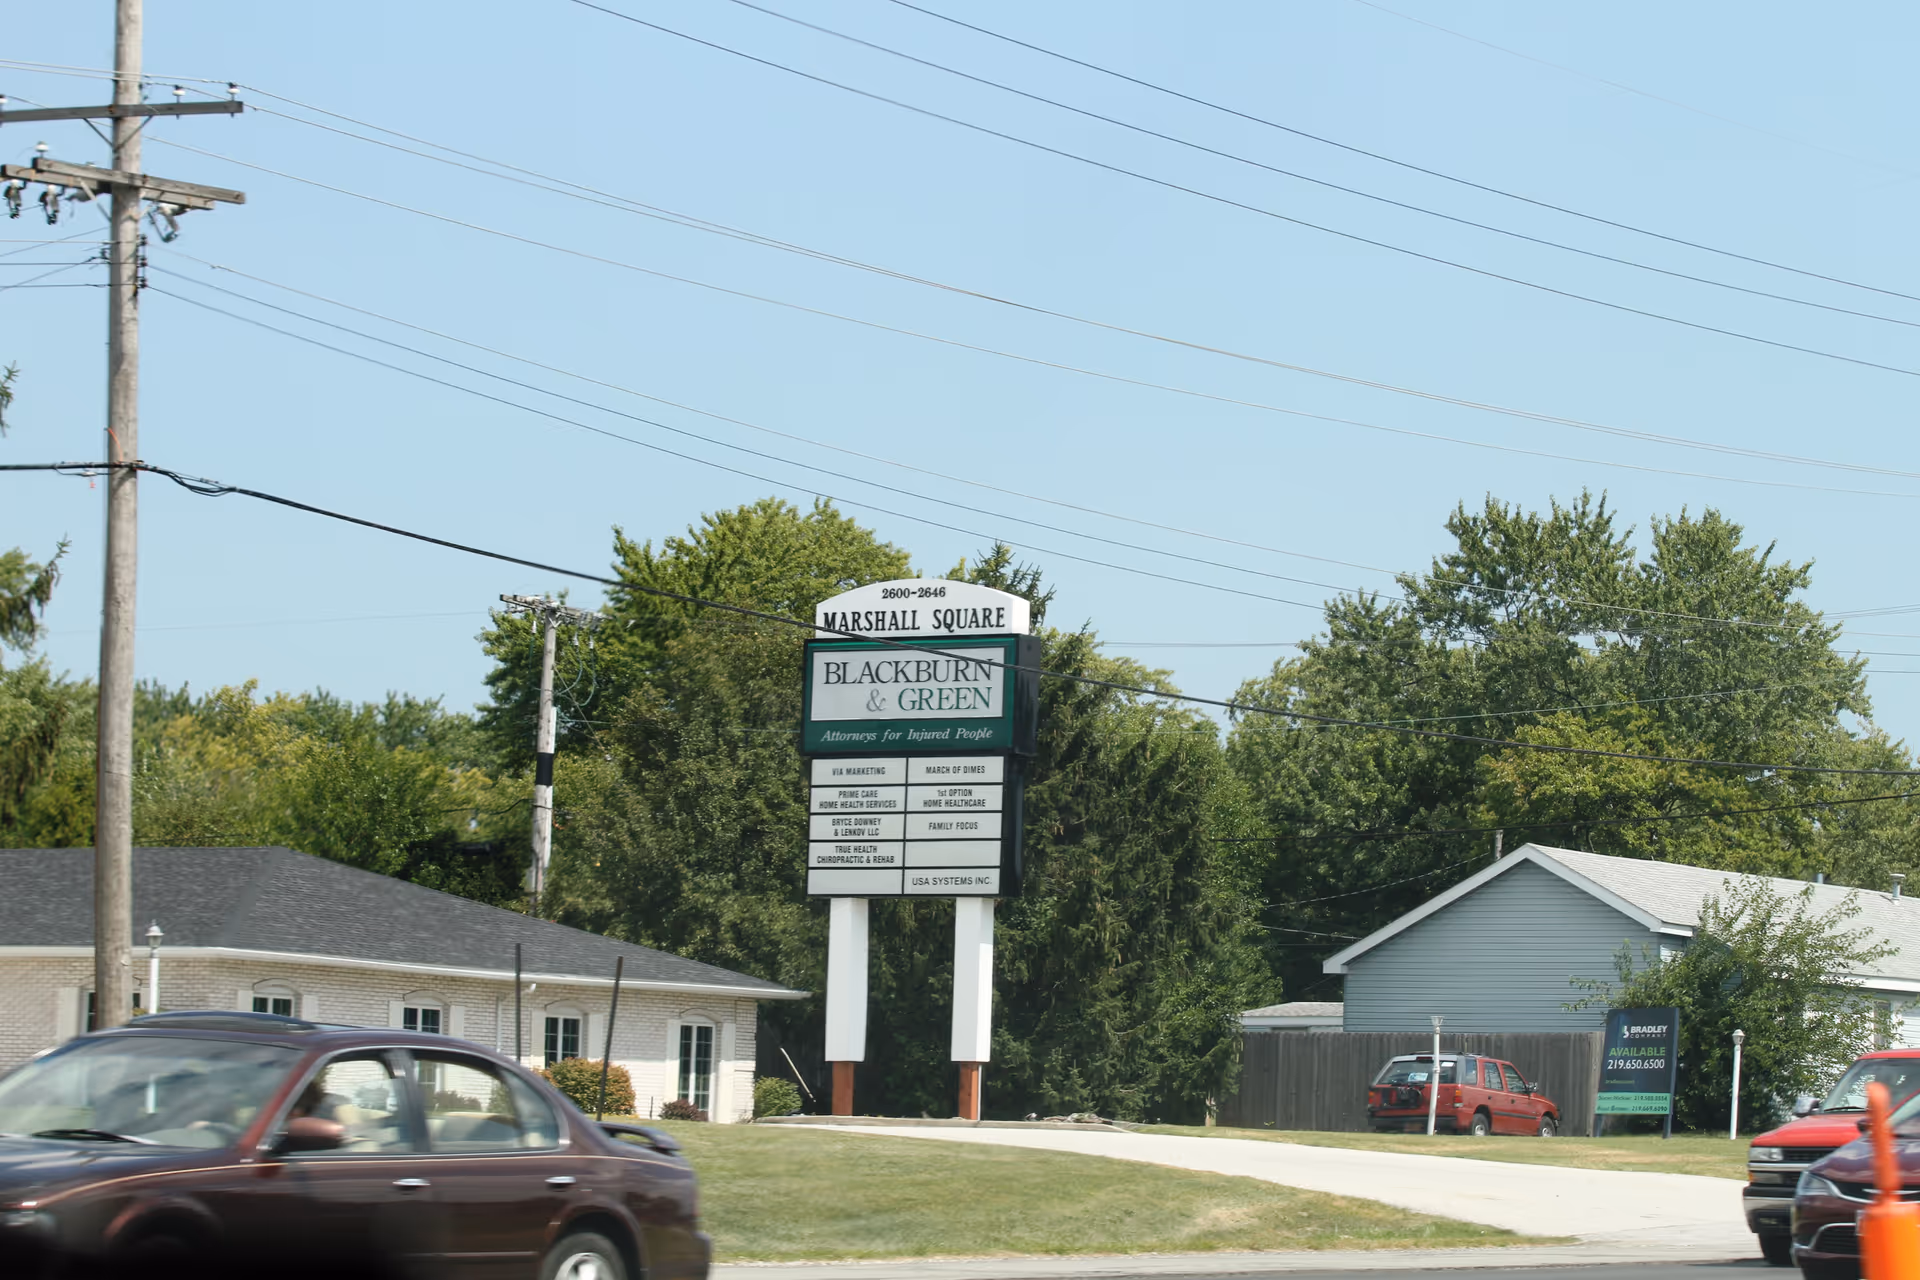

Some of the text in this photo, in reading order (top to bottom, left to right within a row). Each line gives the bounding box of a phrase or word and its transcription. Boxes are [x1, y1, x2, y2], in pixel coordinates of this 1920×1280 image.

[882, 587, 946, 599] 2600-2646
[823, 607, 1005, 632] MARSHALL SQUARE
[824, 658, 994, 685] BLACKBURN
[866, 686, 993, 712] & GREEN
[820, 727, 993, 743] Attorneys for Injured People
[832, 767, 886, 776] VIA MARKETING
[925, 765, 986, 774] MARCH OF DIMES
[838, 789, 878, 798] PRIME CARE
[949, 788, 973, 797] OPTION
[819, 800, 897, 809] HOME HEALTH SERVICES
[923, 799, 986, 808] HOME HEALTHCARE
[832, 817, 882, 826] BRYCE DOWNEY
[928, 821, 978, 830] FAMILY FOCUS
[867, 828, 880, 836] LLC
[835, 845, 877, 853] TRUE HEALTH
[817, 855, 895, 864] CHIROPRACTIC & REHAB
[912, 876, 993, 886] USA SYSTEMS INC.
[1630, 1025, 1668, 1033] BRADLEY
[1608, 1046, 1666, 1057] AVAILABLE
[1607, 1059, 1665, 1070] 219.650.6500
